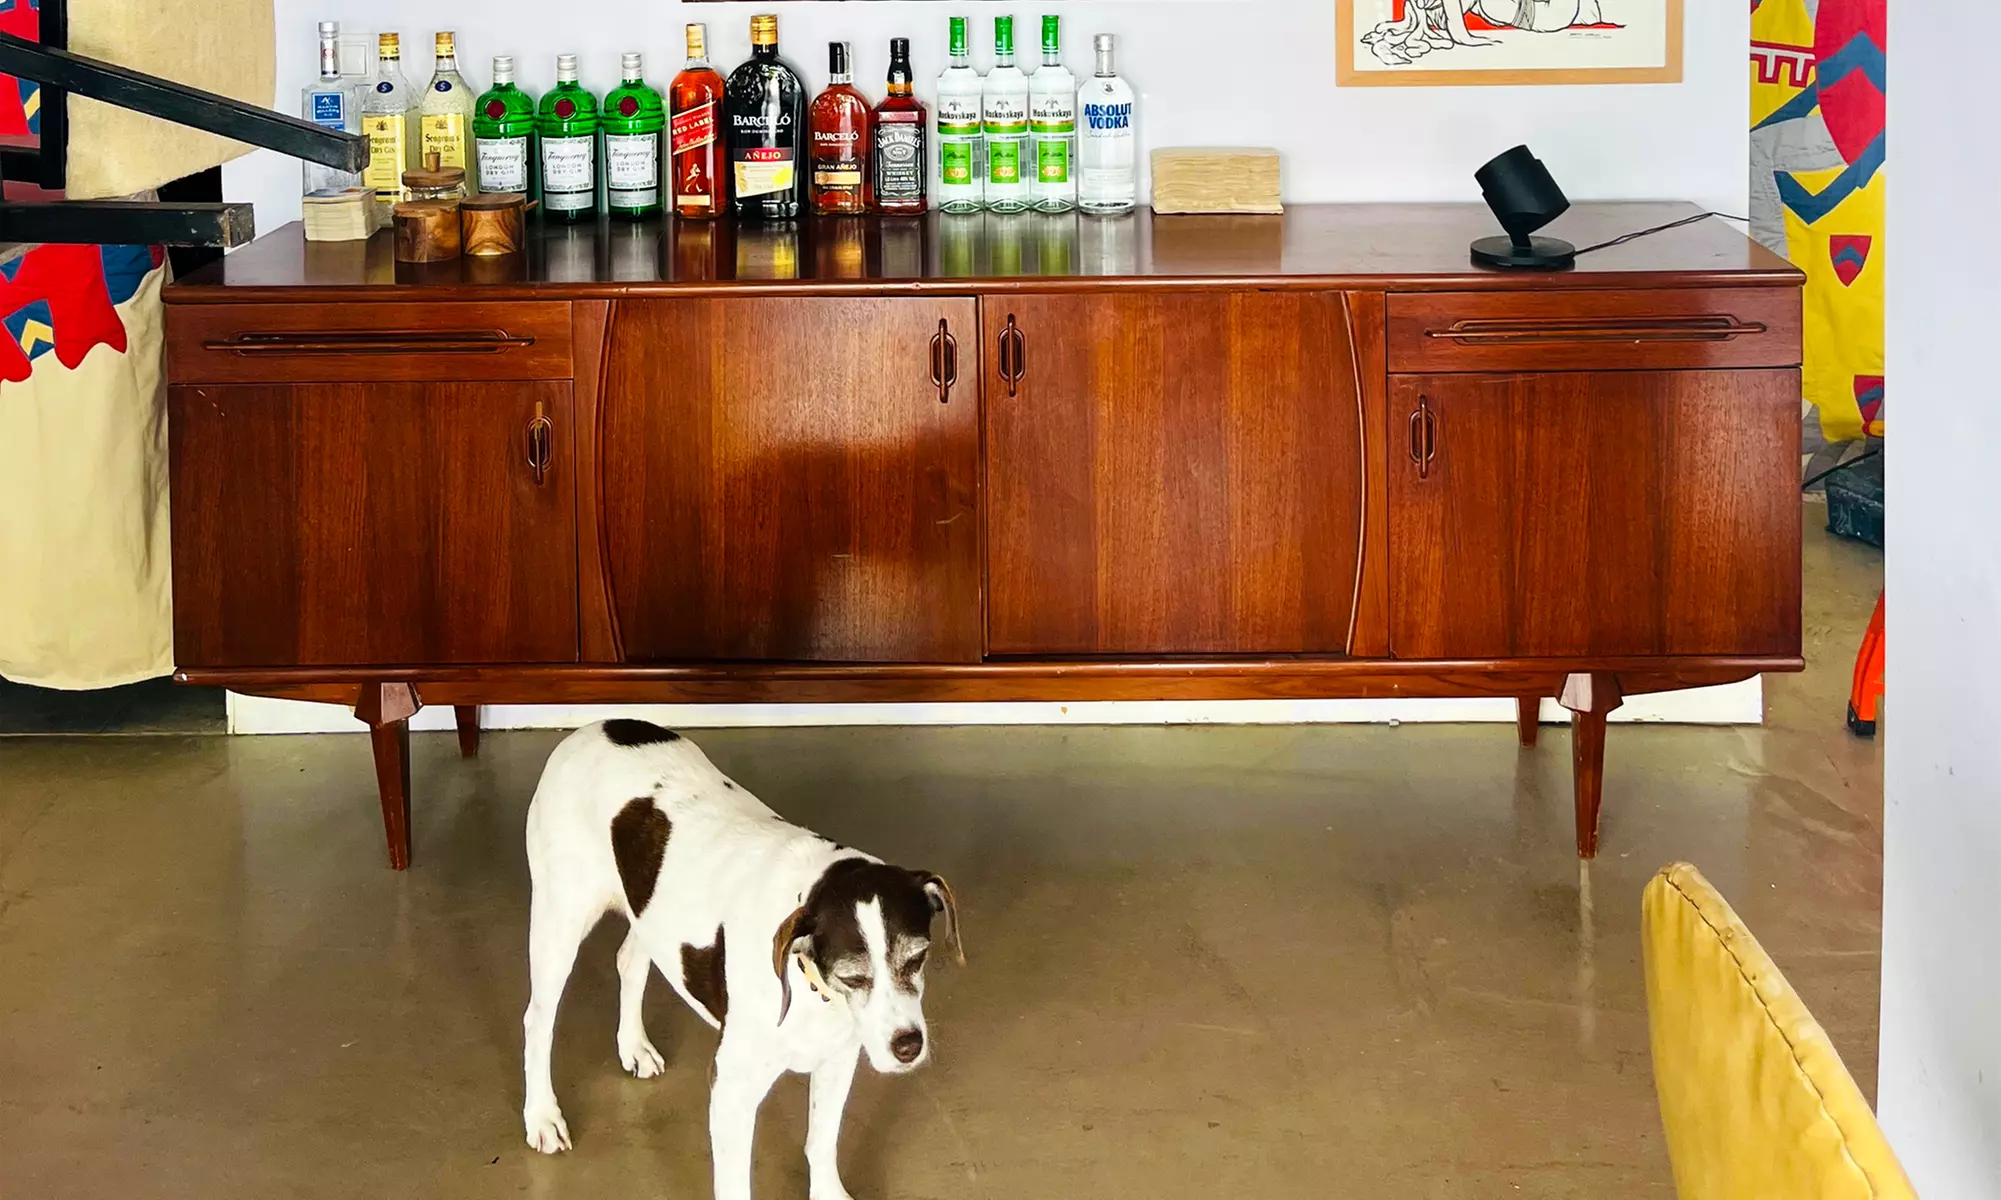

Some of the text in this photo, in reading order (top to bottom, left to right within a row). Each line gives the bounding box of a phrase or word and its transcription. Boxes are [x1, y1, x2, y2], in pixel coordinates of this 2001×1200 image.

[1084, 102, 1132, 116] ABSOLUT
[672, 125, 688, 135] RED
[689, 116, 714, 130] LABEL
[1089, 115, 1129, 130] VODKA
[425, 133, 460, 145] Seagrams
[814, 131, 859, 141] BARCELÓ
[878, 131, 921, 149] JACK DANIEL'S
[745, 150, 782, 160] AÑEJO
[836, 162, 857, 170] AÑEJO
